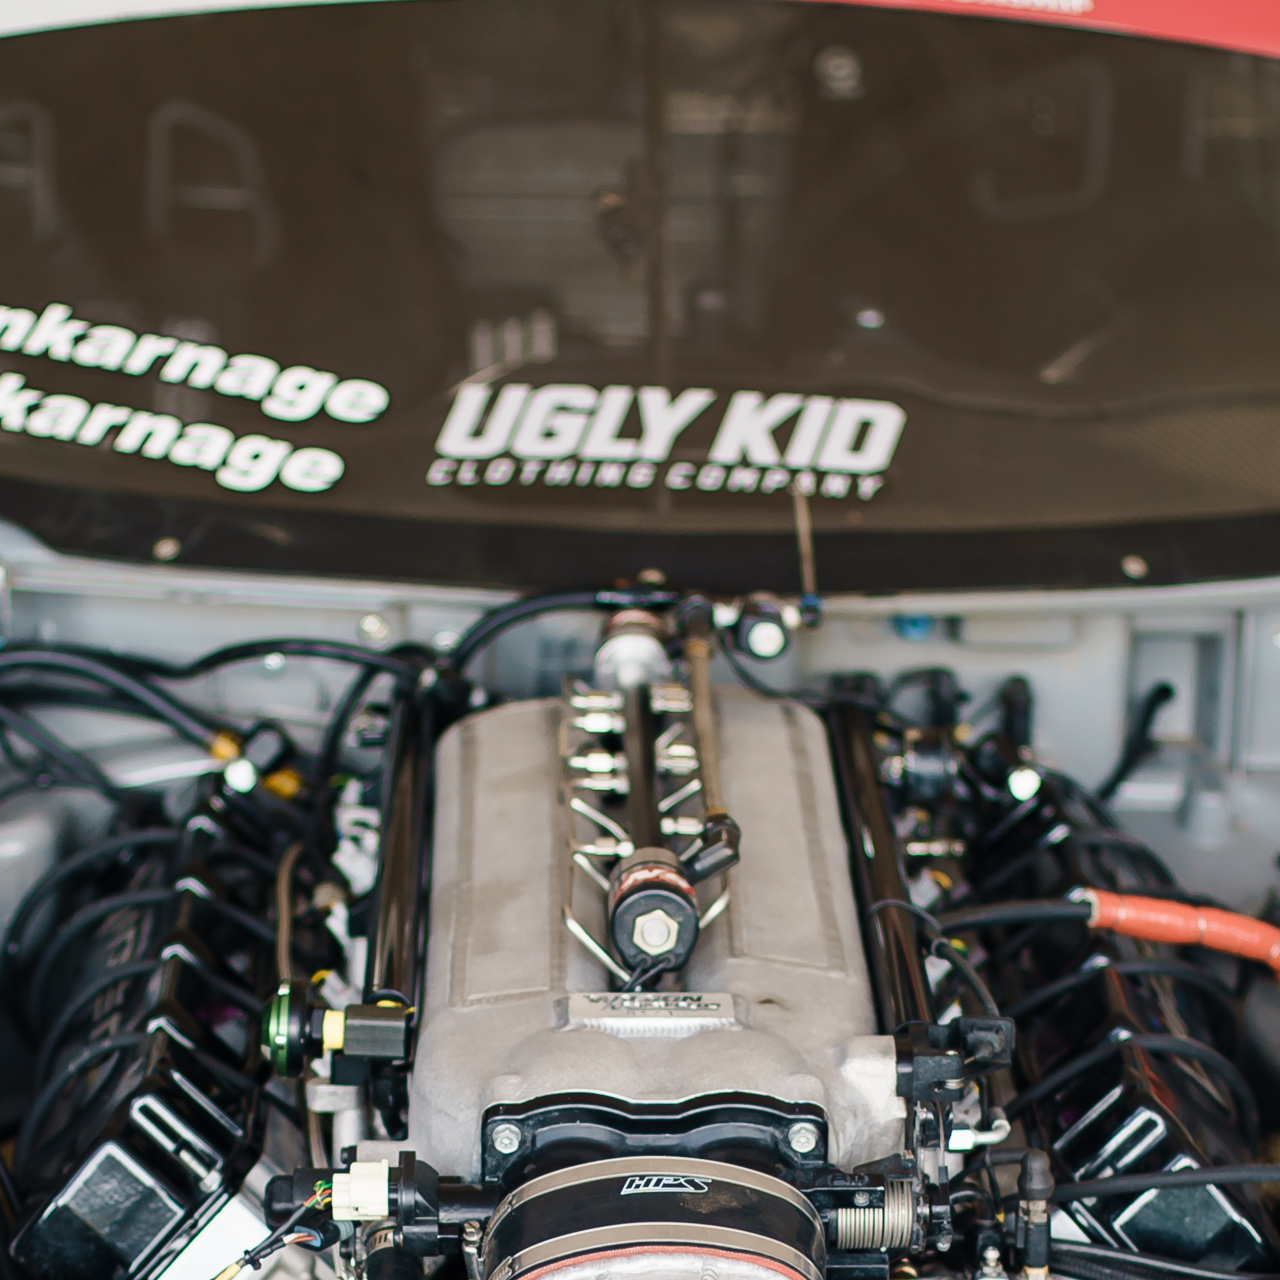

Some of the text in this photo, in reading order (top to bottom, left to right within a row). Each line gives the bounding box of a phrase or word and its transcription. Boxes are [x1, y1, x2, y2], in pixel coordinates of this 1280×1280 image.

[435, 383, 907, 475] UGLY KID
[426, 457, 885, 500] CLOTHING COMPANY
[620, 1176, 712, 1196] HPS
